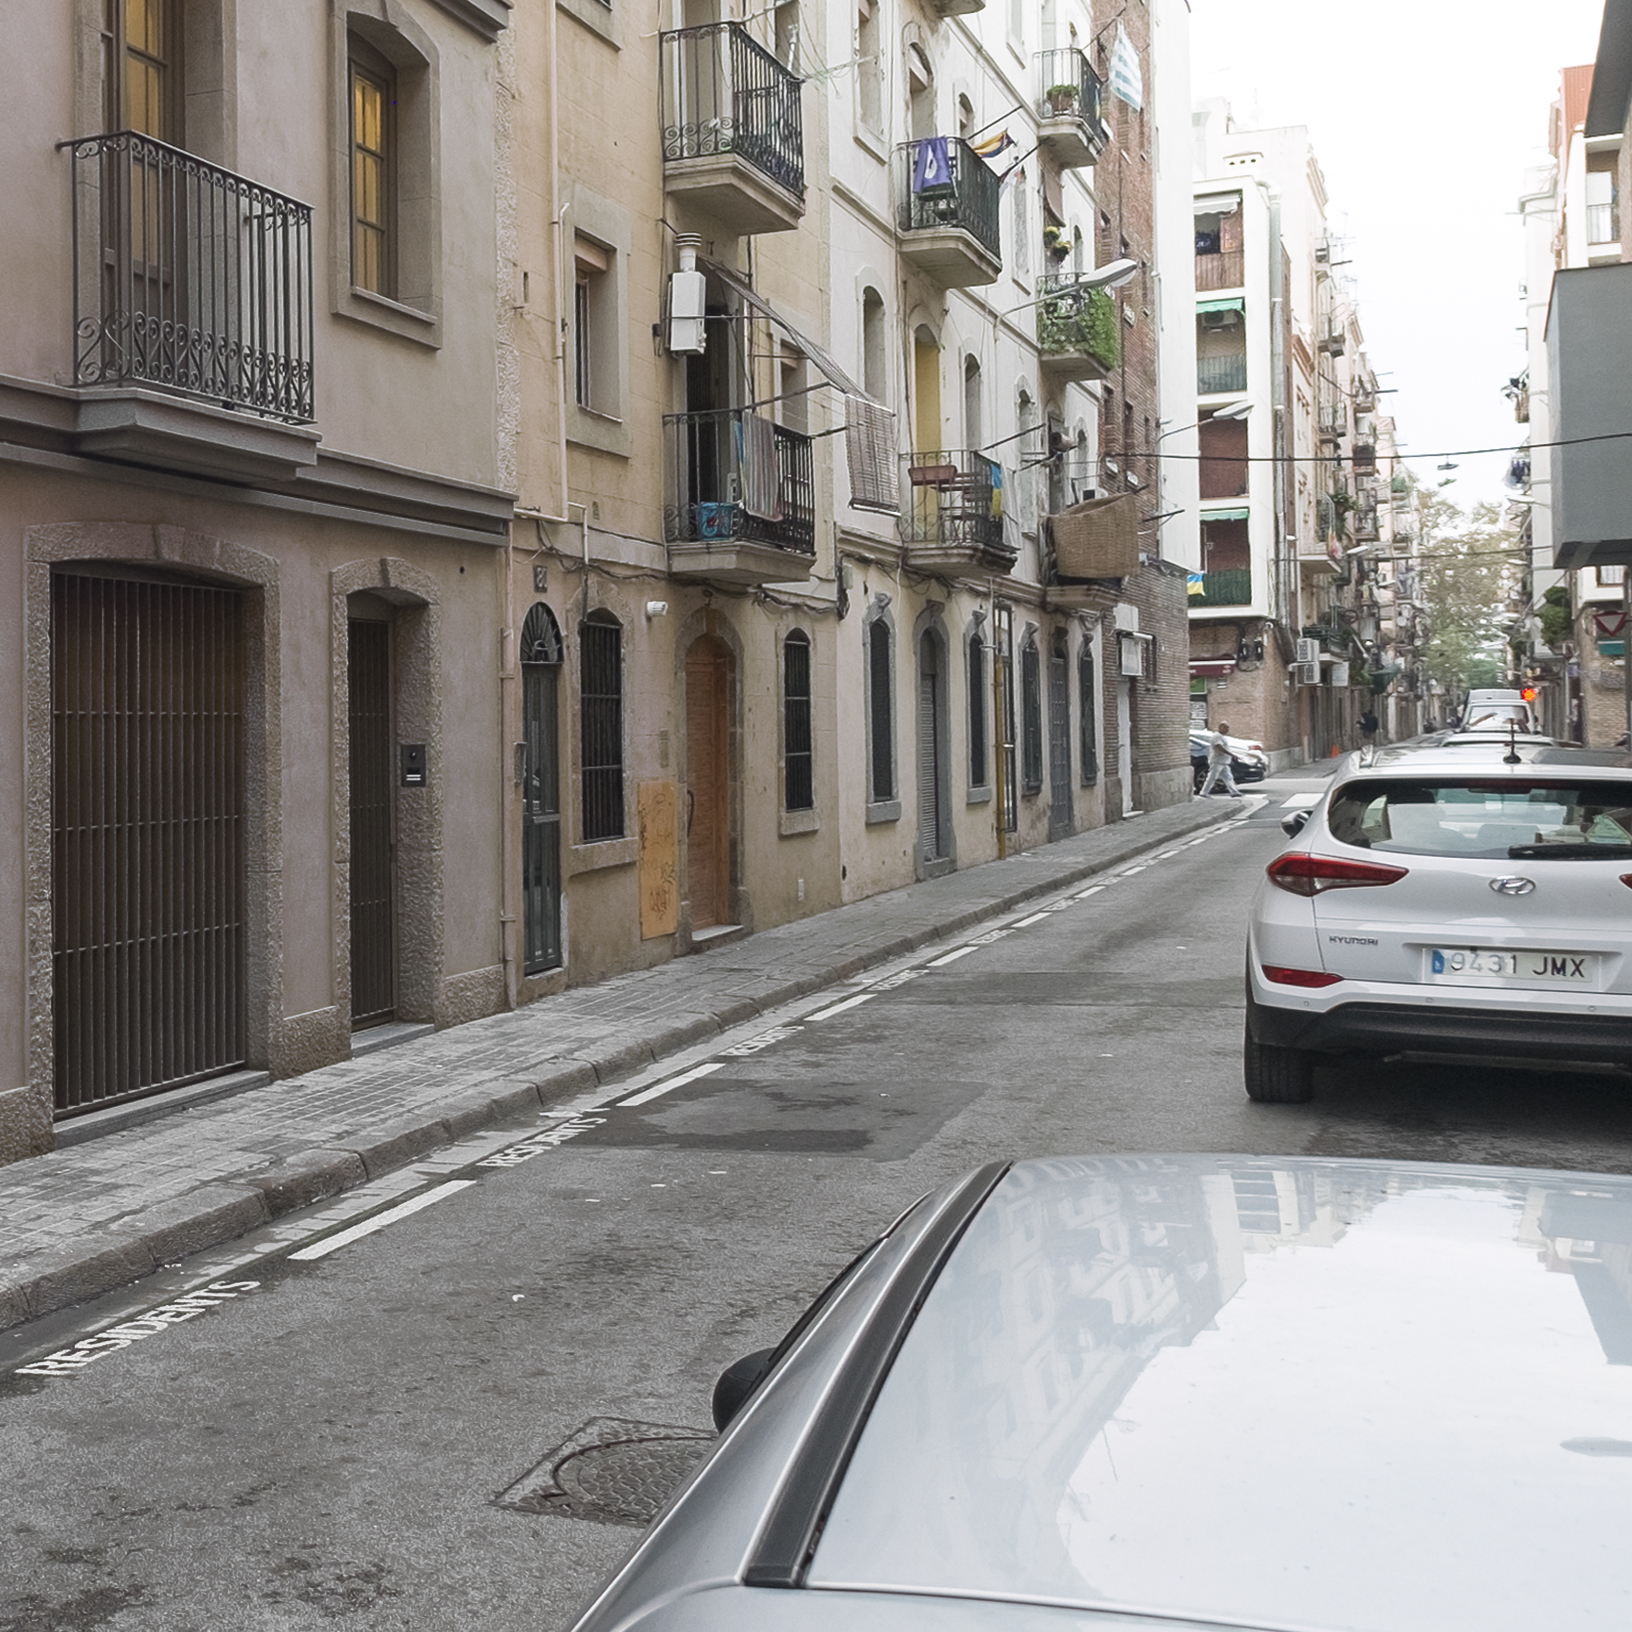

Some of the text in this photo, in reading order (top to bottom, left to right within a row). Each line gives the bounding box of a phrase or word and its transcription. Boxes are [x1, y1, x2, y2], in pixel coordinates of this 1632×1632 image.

[1450, 952, 1586, 979] 9431 JMX
[475, 1117, 607, 1168] RESIDENTS
[14, 1280, 261, 1376] RESIDENTS
